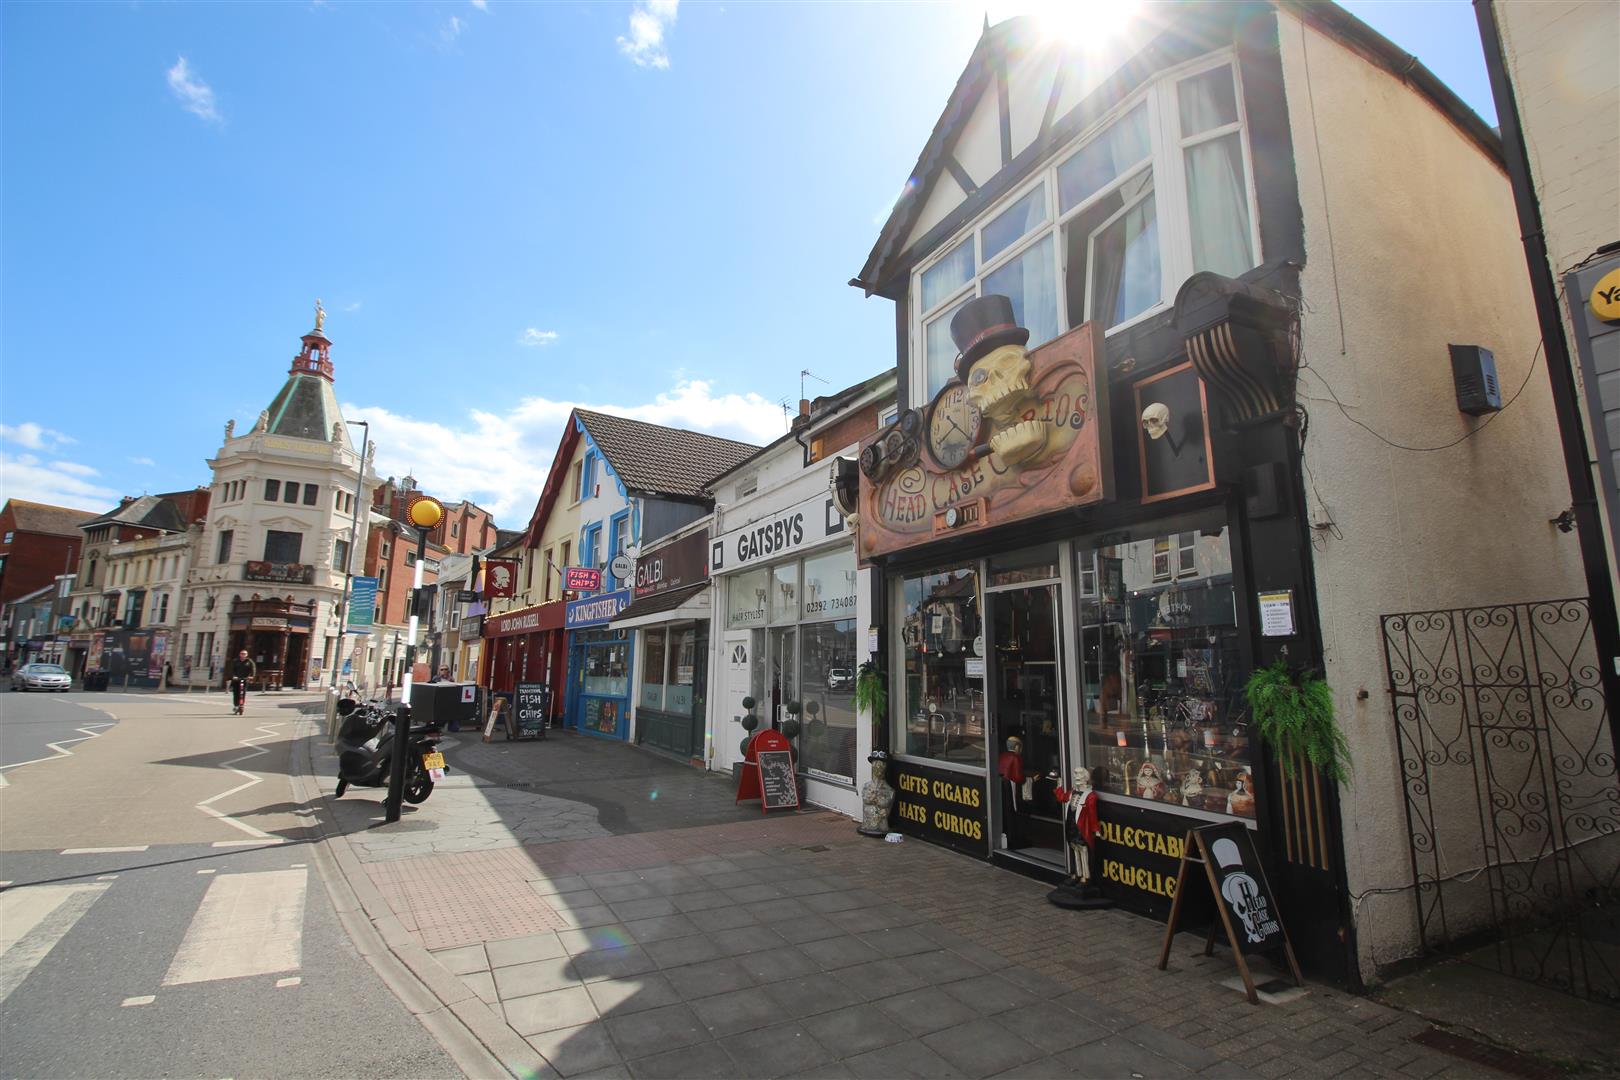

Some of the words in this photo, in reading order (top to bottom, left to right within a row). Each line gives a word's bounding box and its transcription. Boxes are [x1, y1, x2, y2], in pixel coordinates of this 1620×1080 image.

[882, 488, 927, 523] HEAD
[930, 465, 984, 510] CASE
[738, 513, 804, 562] GATSBYS
[570, 571, 589, 579] FISH
[636, 559, 663, 587] GALBI
[570, 579, 595, 587] CHIPS
[575, 598, 618, 622] KINGFISHER
[806, 601, 828, 613] 02392
[831, 595, 858, 610] 734087
[500, 619, 511, 632] LORD
[511, 616, 523, 631] JOHN
[523, 613, 539, 628] RUSSELL
[732, 612, 744, 623] HAIR
[744, 609, 764, 621] STYLIST
[1280, 644, 1288, 655] 4
[465, 689, 472, 699] L
[520, 695, 541, 704] FISH
[519, 709, 542, 719] CHIPS
[899, 773, 929, 795] GIFTS
[932, 780, 980, 808] CIGARS
[899, 801, 927, 824] HATS
[934, 810, 982, 840] CURIOS
[1102, 858, 1178, 899] JEWELLE
